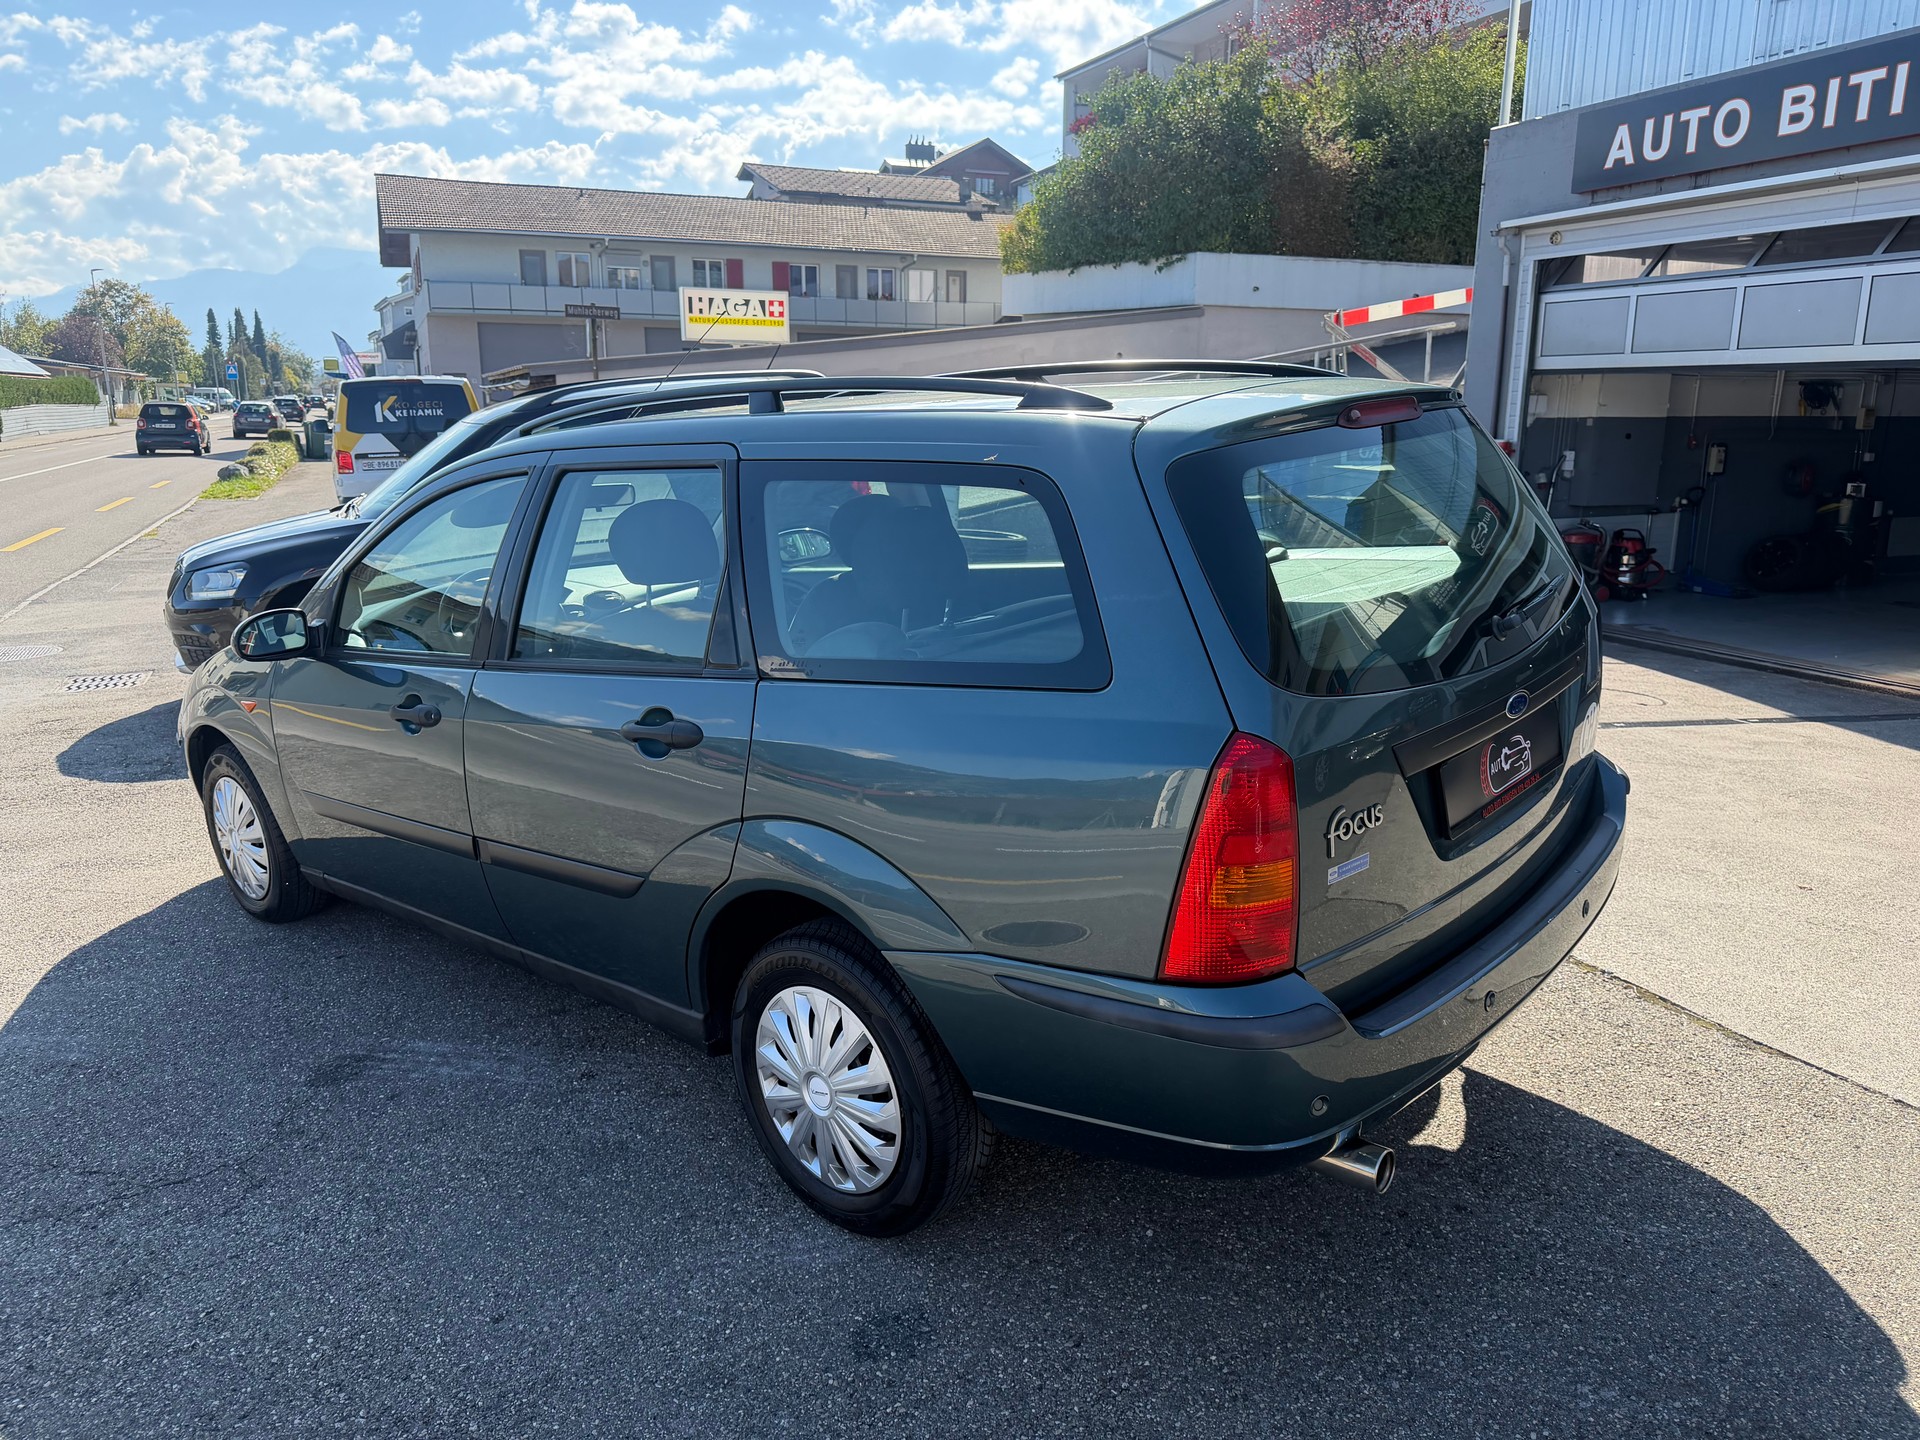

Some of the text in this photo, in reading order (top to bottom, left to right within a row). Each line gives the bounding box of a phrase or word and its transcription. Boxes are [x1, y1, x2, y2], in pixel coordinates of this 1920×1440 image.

[1603, 61, 1911, 170] AUTO BITI
[688, 296, 767, 318] HAGA
[394, 401, 443, 409] KOGECI
[395, 408, 444, 417] KERAMIK
